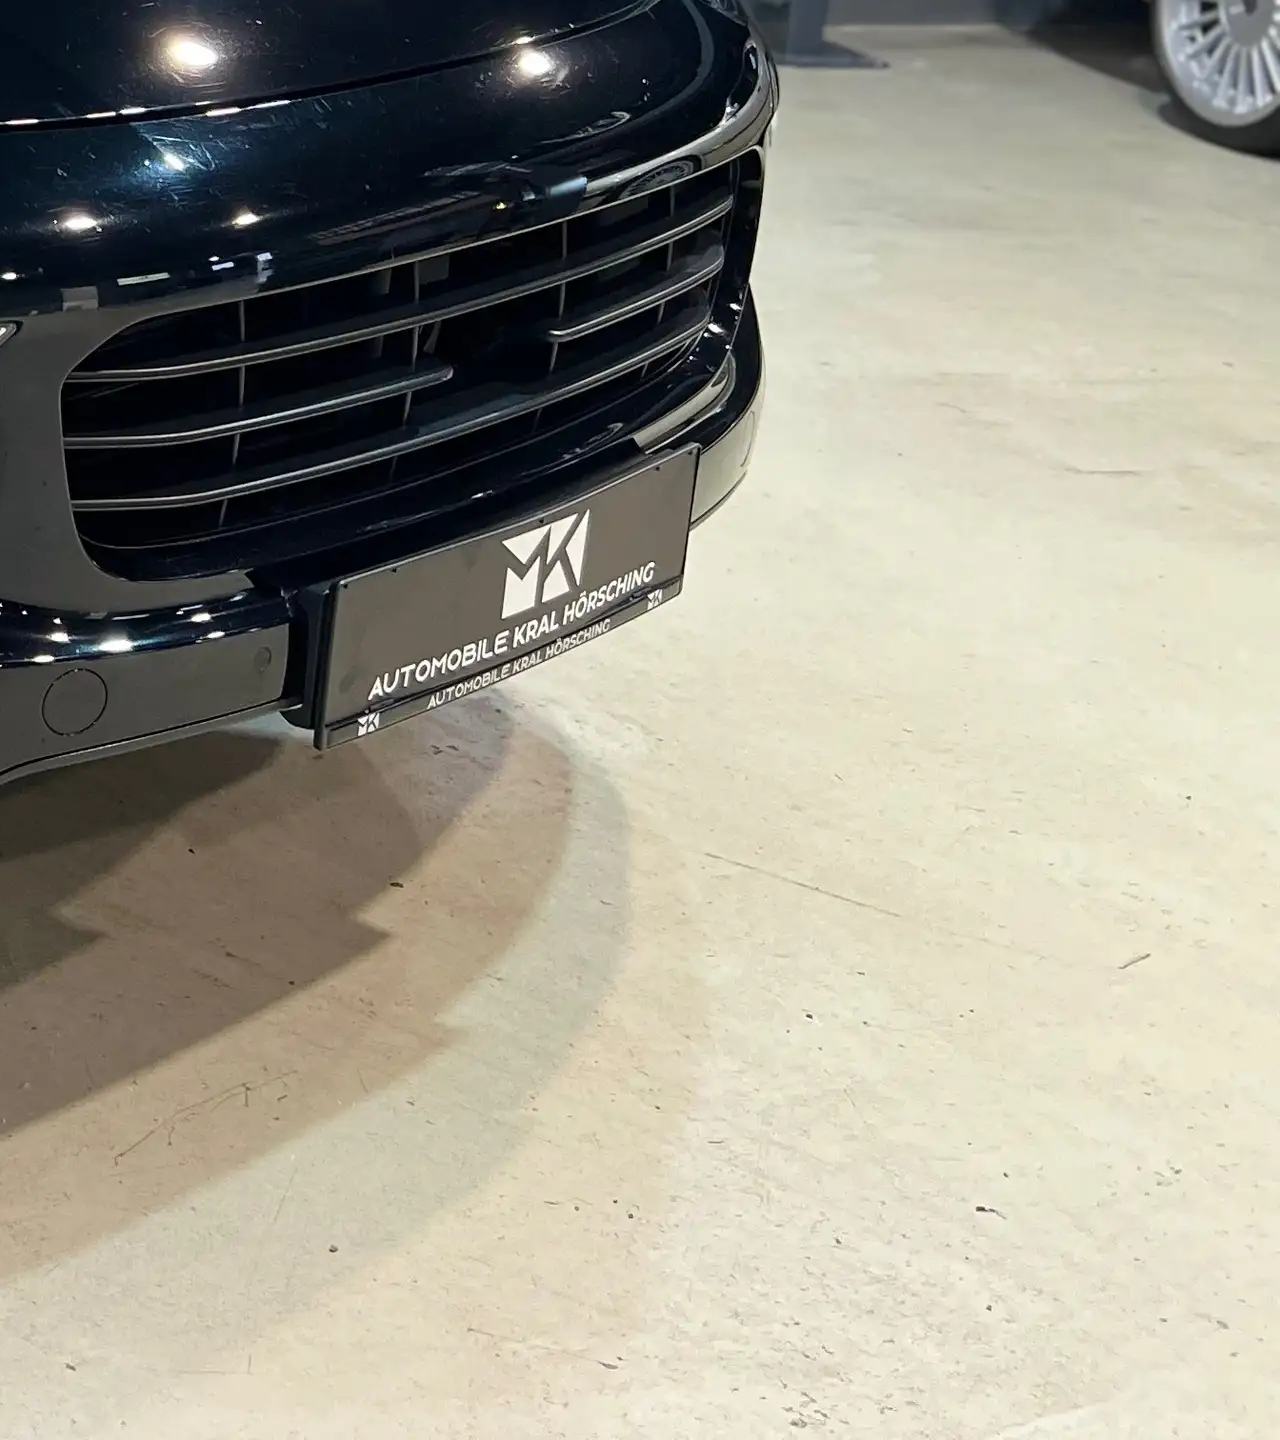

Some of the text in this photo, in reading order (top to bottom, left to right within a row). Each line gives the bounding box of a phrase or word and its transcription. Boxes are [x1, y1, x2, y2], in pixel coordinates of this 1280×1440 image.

[501, 509, 590, 620] MK
[367, 561, 656, 701] AUTOMOBILE KRAL HÖRSCHING
[426, 618, 611, 710] AUTOMOBILE KRAL HÖRSCHING
